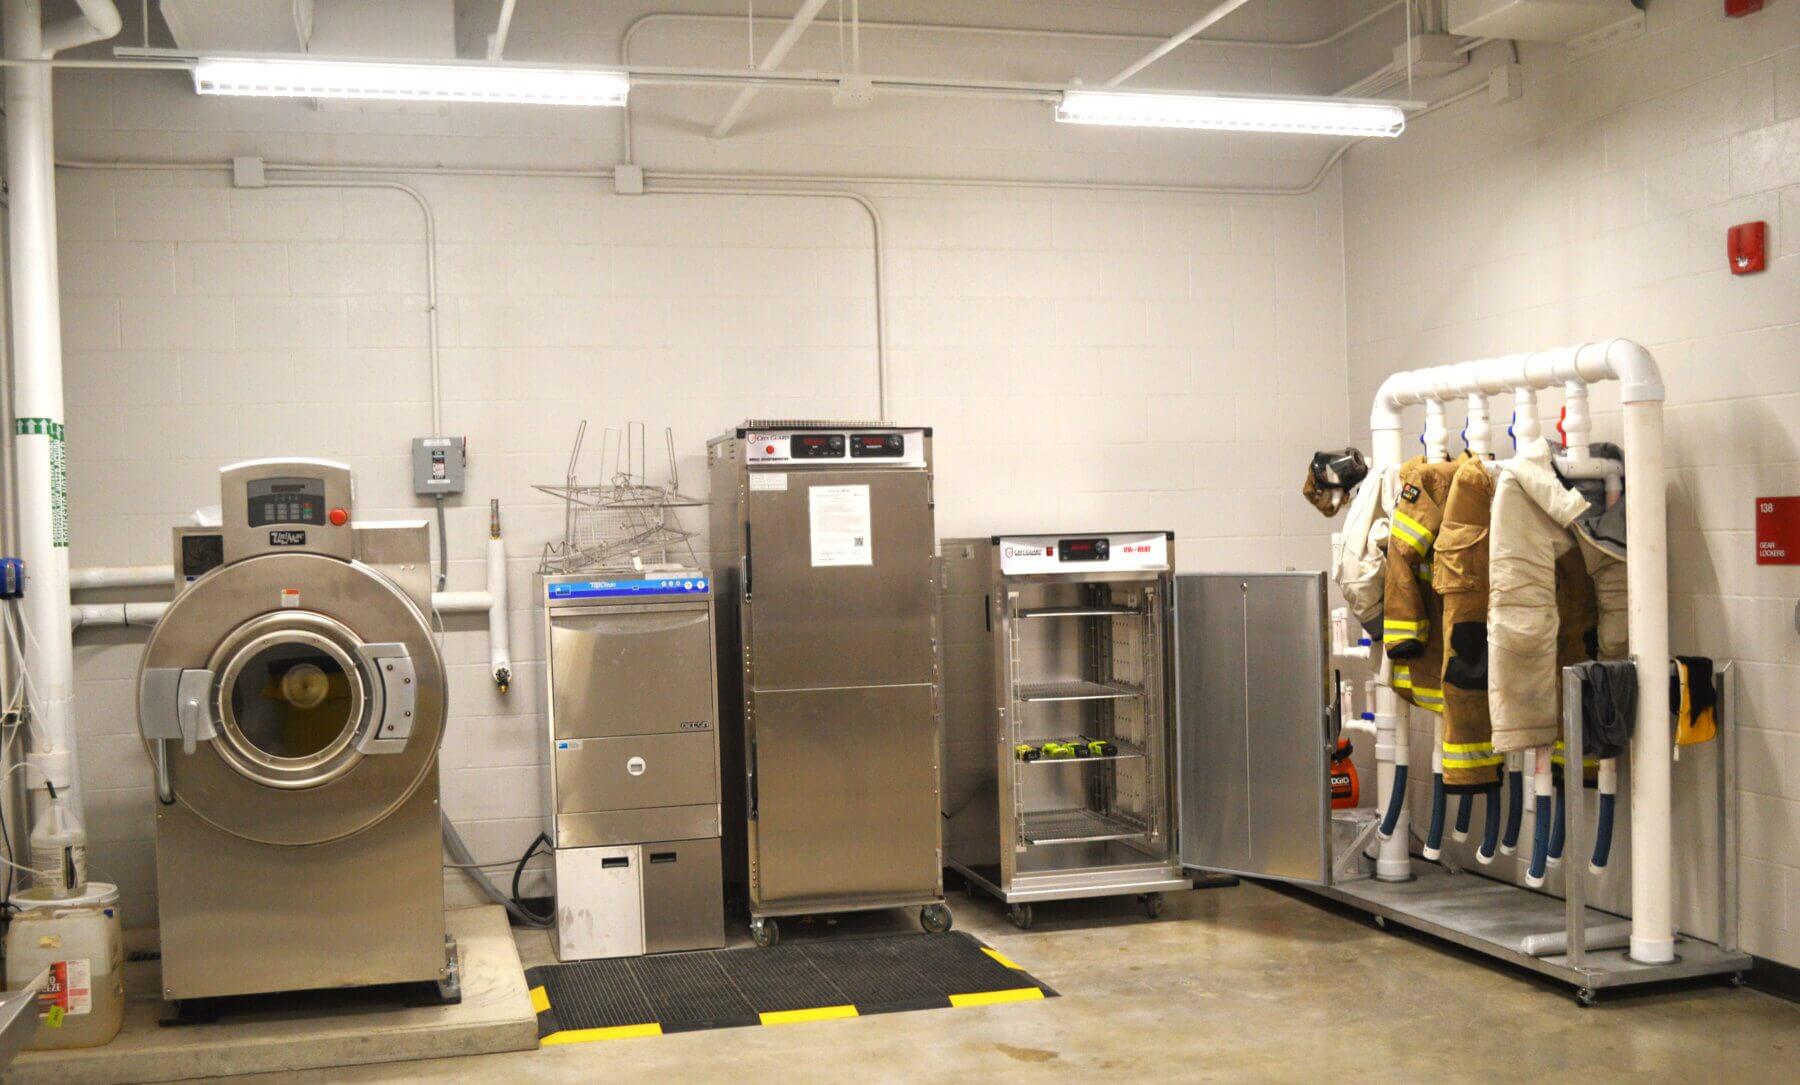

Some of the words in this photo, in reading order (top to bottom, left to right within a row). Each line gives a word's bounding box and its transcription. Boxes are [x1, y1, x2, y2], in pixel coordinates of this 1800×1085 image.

[1760, 502, 1774, 513] 138
[1759, 541, 1775, 549] GEAR
[1759, 549, 1785, 557] LOCKERS
[1331, 776, 1350, 785] DGID
